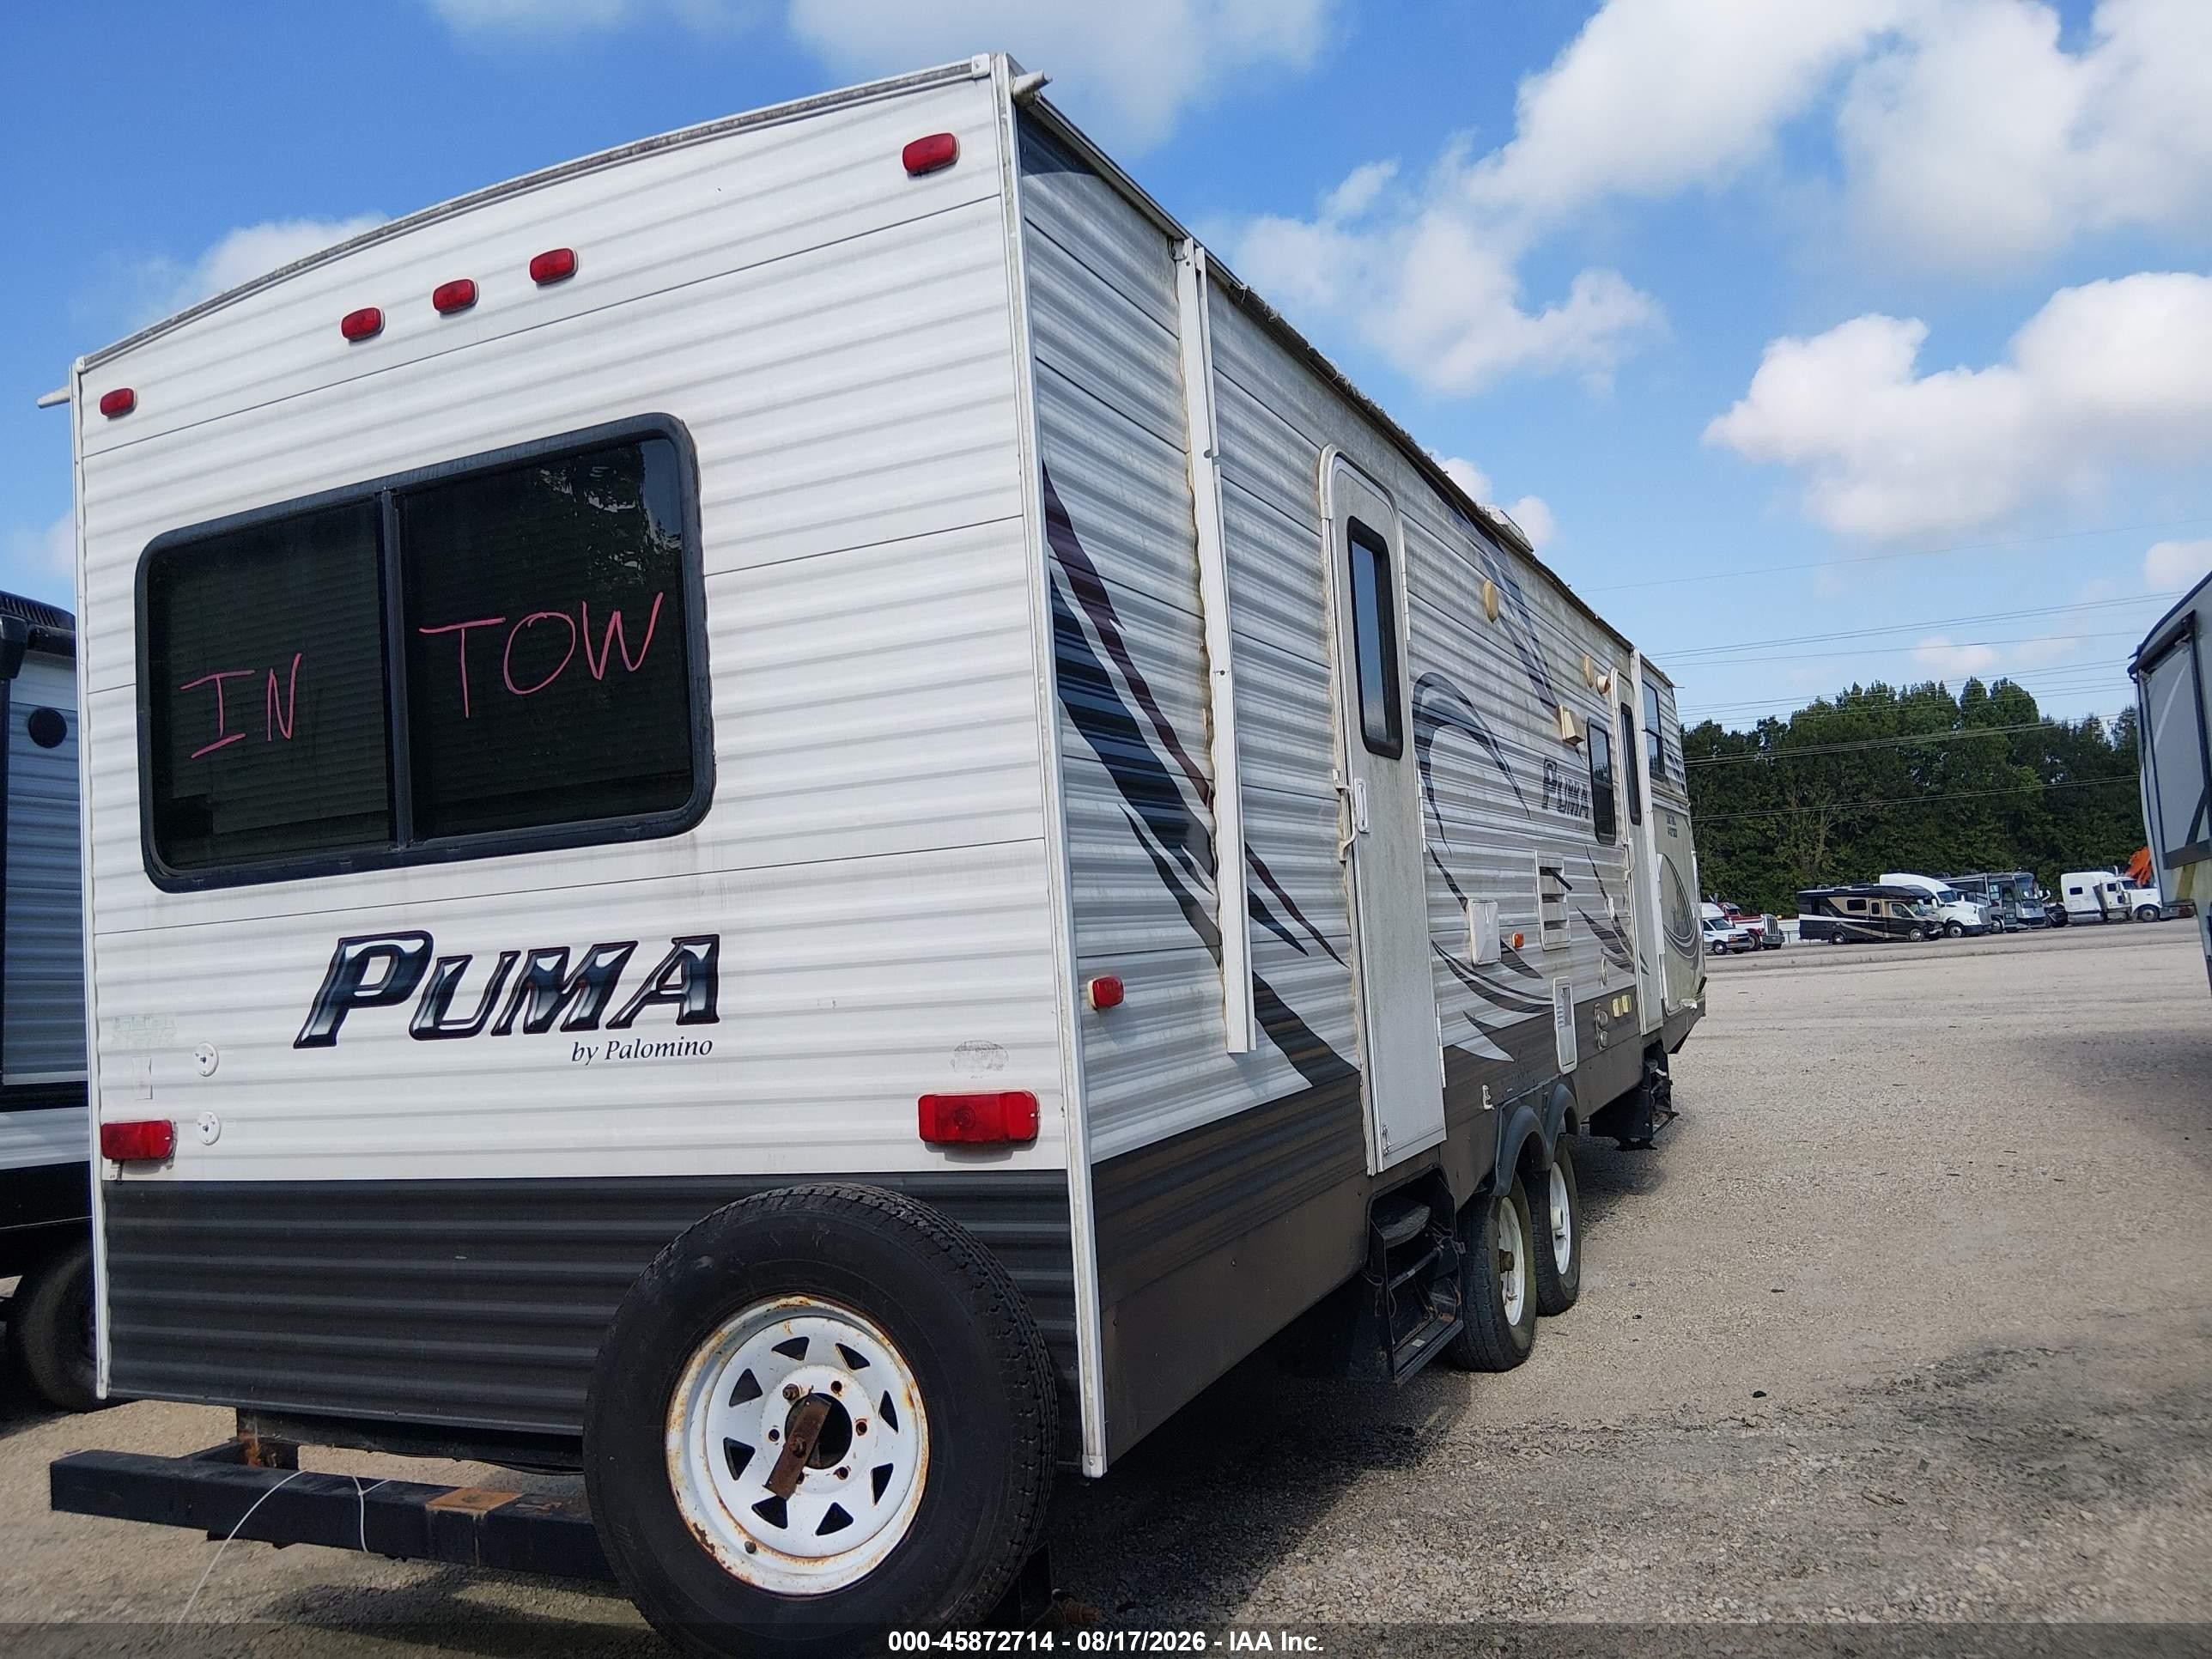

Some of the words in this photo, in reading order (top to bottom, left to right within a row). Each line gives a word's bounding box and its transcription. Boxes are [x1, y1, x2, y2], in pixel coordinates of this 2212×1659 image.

[179, 652, 302, 759] IN
[418, 591, 664, 720] TOW
[1540, 757, 1589, 819] PUMA
[293, 930, 721, 1049] PUMA
[571, 1041, 600, 1066] by
[605, 1035, 714, 1061] Palomino
